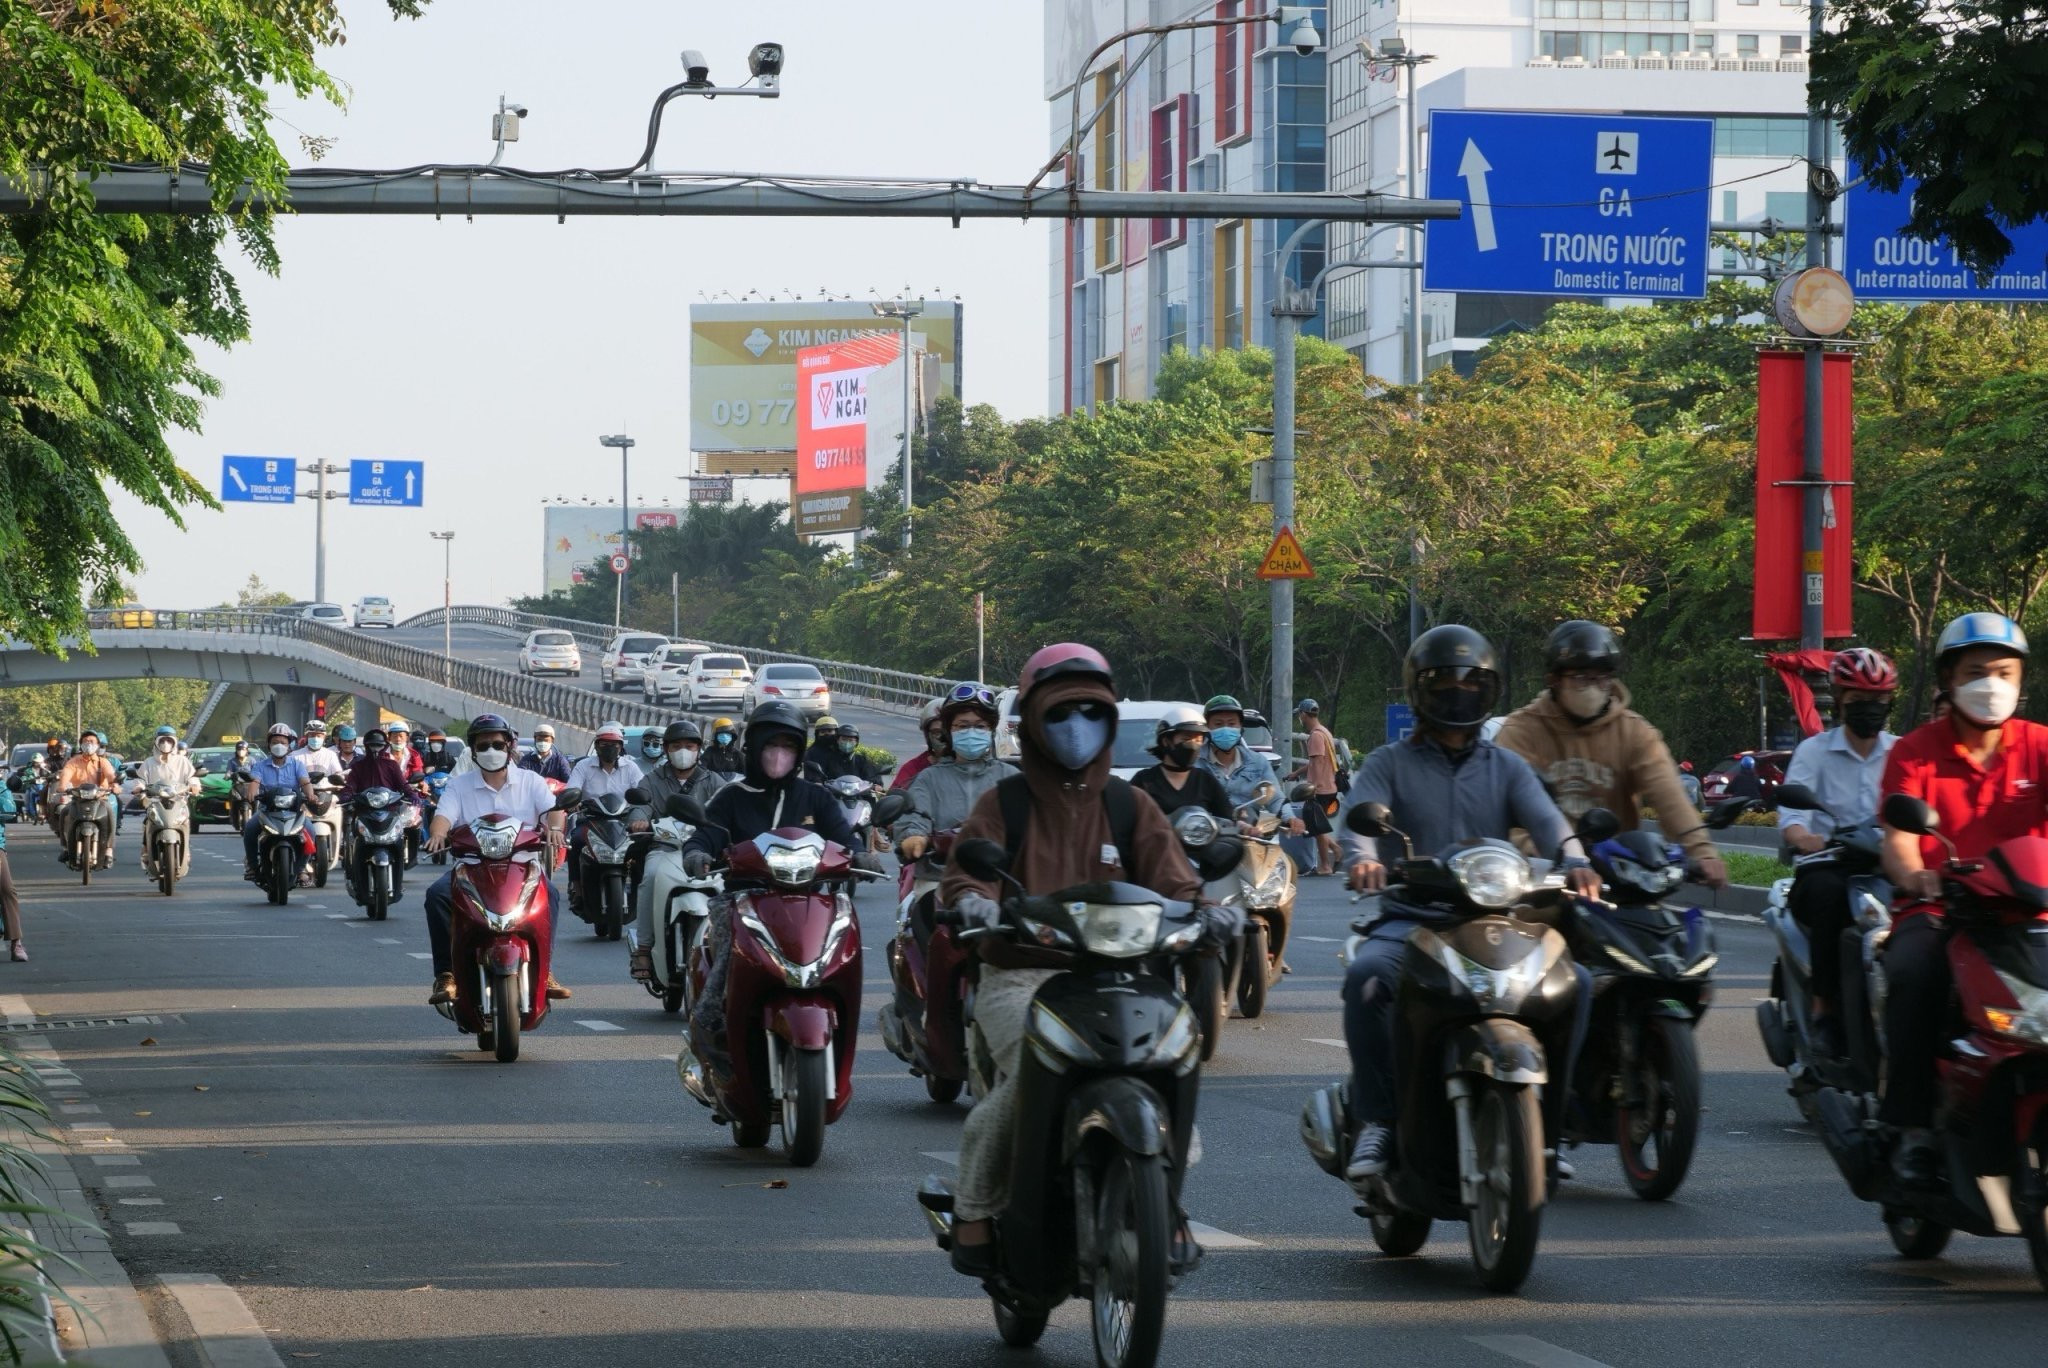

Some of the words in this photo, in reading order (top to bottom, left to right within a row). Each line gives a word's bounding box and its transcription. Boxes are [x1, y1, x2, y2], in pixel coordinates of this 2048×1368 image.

[1599, 187, 1633, 217] GA
[1540, 233, 1618, 264] TRONG
[1624, 228, 1686, 266] NƯỚC
[1554, 268, 1620, 289] Domestic
[1624, 270, 1685, 292] Terminal
[1855, 268, 1969, 290] International
[1974, 269, 2047, 290] rminal
[778, 328, 811, 346] KIM
[836, 377, 859, 398] KIM
[712, 398, 751, 426] 09
[757, 399, 796, 425] 77
[1280, 546, 1291, 556] ĐI
